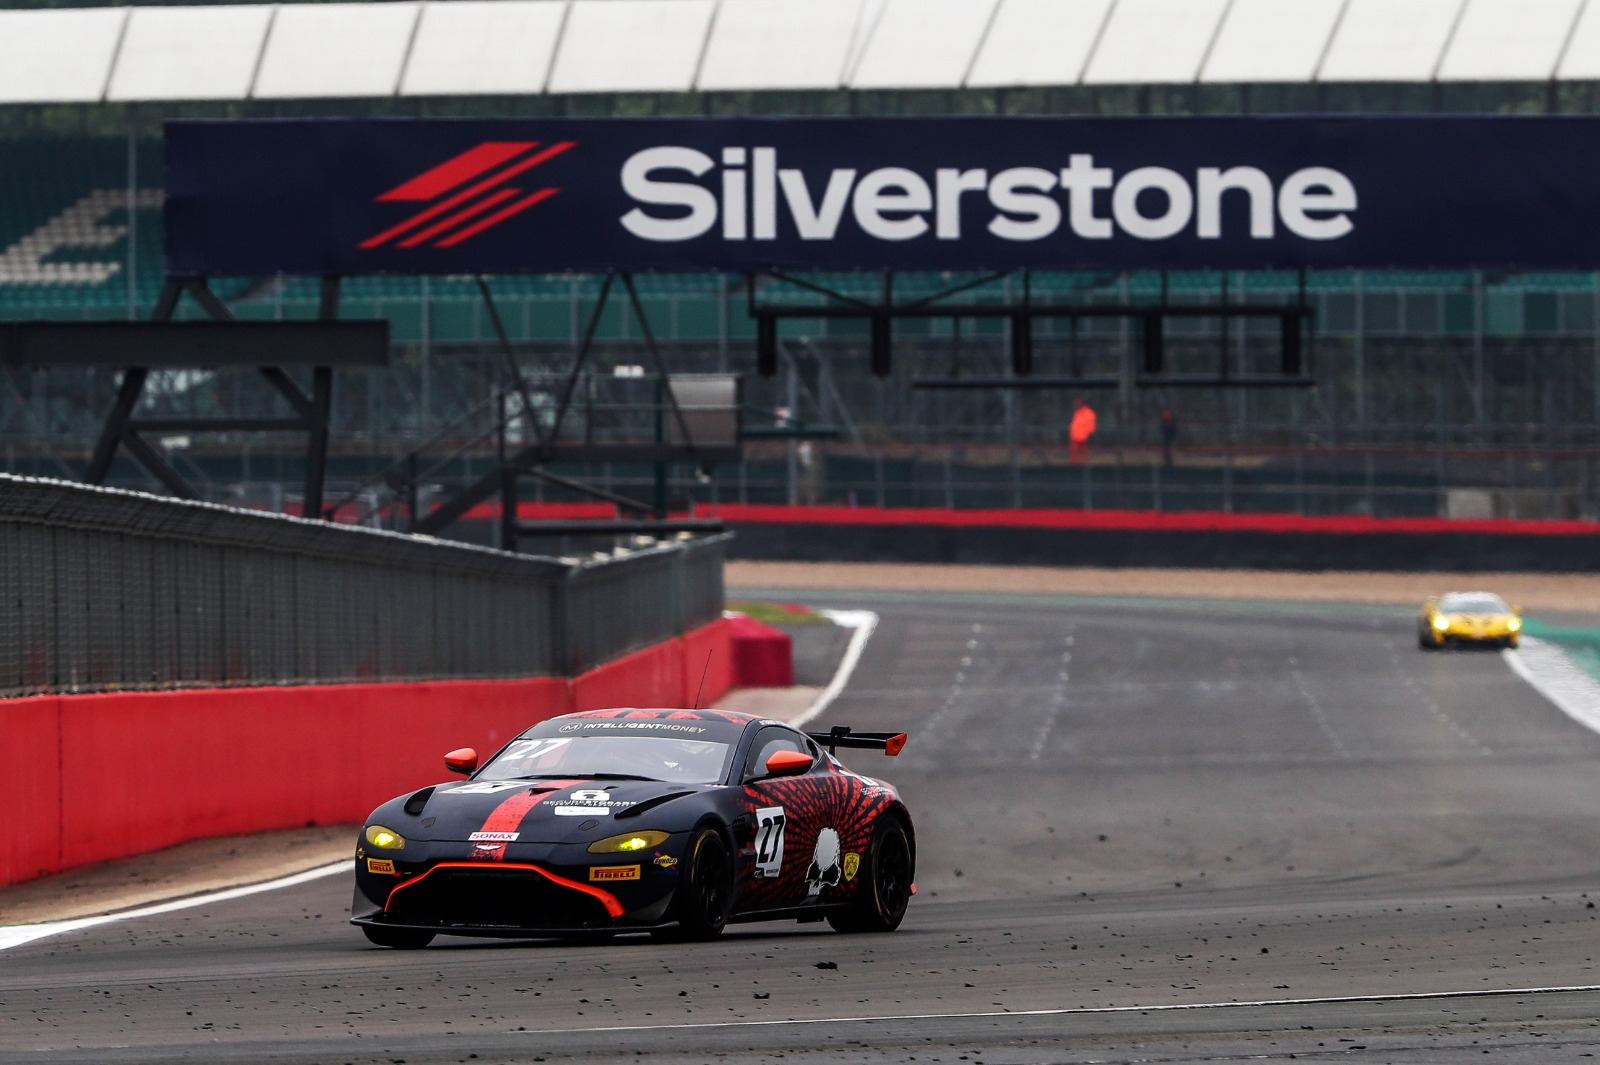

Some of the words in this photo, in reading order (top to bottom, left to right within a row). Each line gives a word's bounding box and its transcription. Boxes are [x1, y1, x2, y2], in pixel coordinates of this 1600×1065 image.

[620, 146, 1357, 242] Silverstone
[501, 738, 572, 761] 27
[471, 832, 515, 840] SONAX
[757, 814, 785, 864] 27
[369, 860, 392, 872] PIRELLI
[593, 868, 636, 879] PIRELLI
